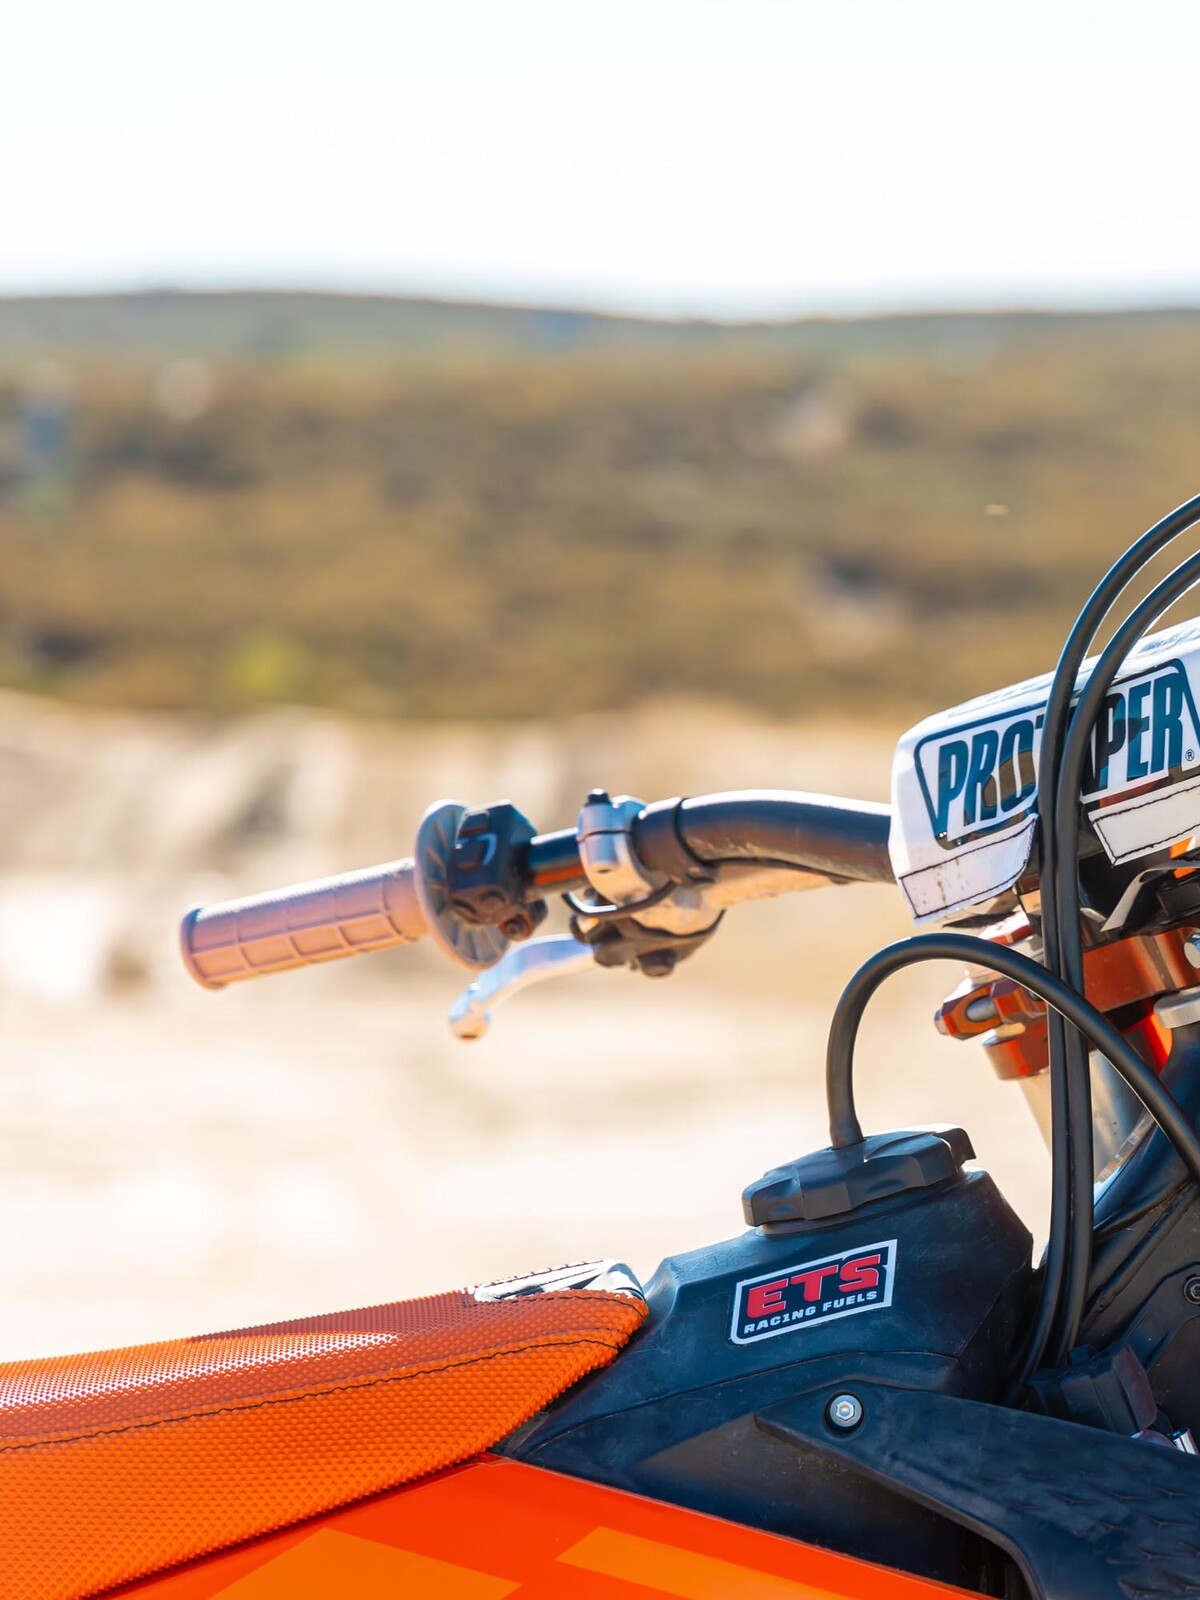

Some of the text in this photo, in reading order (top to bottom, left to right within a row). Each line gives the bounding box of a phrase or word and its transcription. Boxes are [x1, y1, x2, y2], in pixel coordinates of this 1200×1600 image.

[935, 669, 1185, 835] PROPER
[744, 1290, 877, 1335] RACING FUELS
[746, 1254, 881, 1319] ETS
